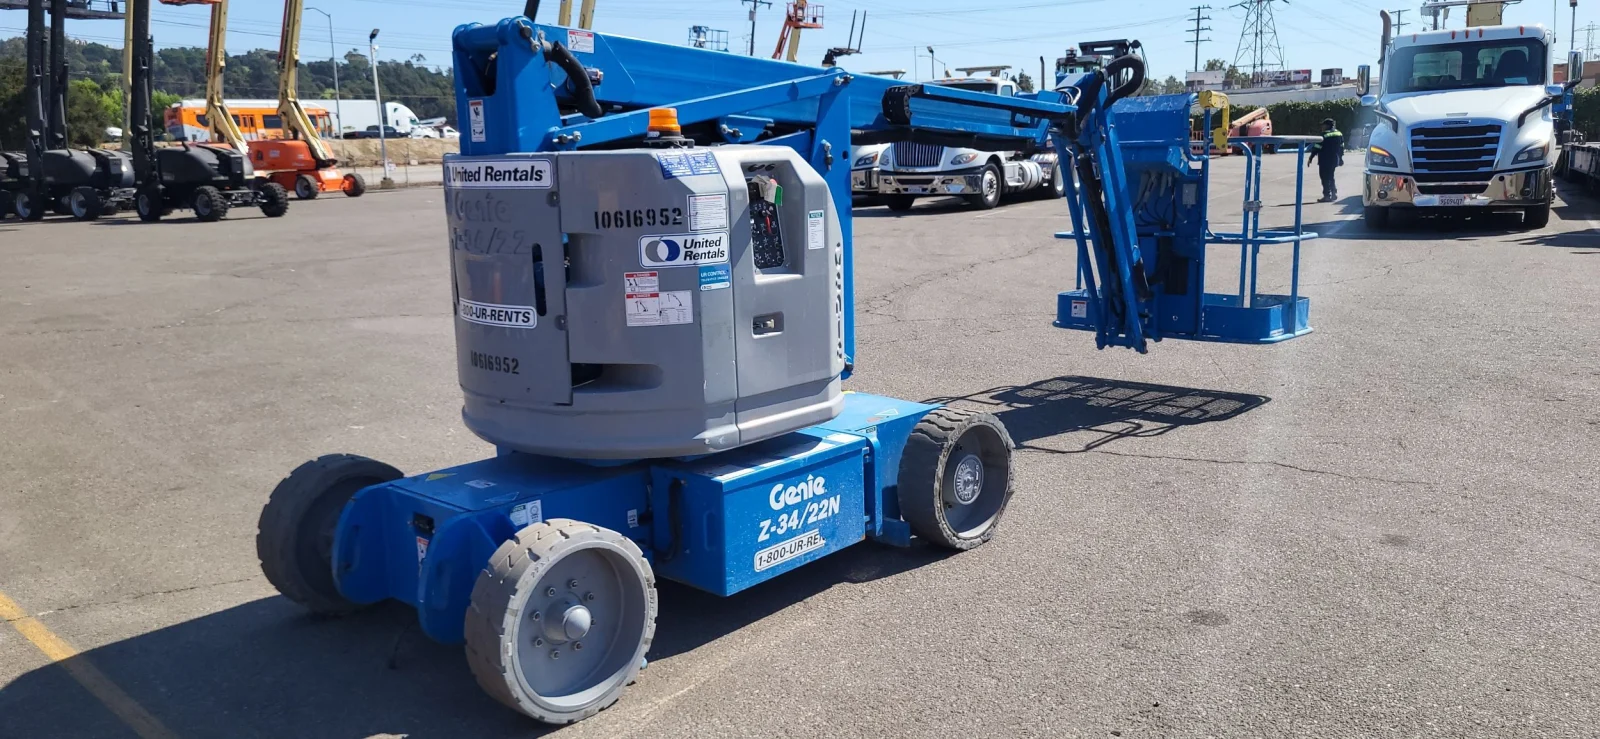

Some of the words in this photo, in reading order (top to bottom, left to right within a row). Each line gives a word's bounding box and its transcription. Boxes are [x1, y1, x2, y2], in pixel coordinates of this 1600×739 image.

[452, 165, 481, 182] United
[484, 165, 544, 182] Rentals
[594, 207, 682, 230] 10616952
[683, 236, 722, 250] United
[683, 248, 726, 261] Rentals
[461, 304, 531, 324] -800-UR-RENTS
[470, 350, 520, 375] 10616952
[769, 474, 826, 511] Genie
[757, 494, 841, 543] Z-34/22N
